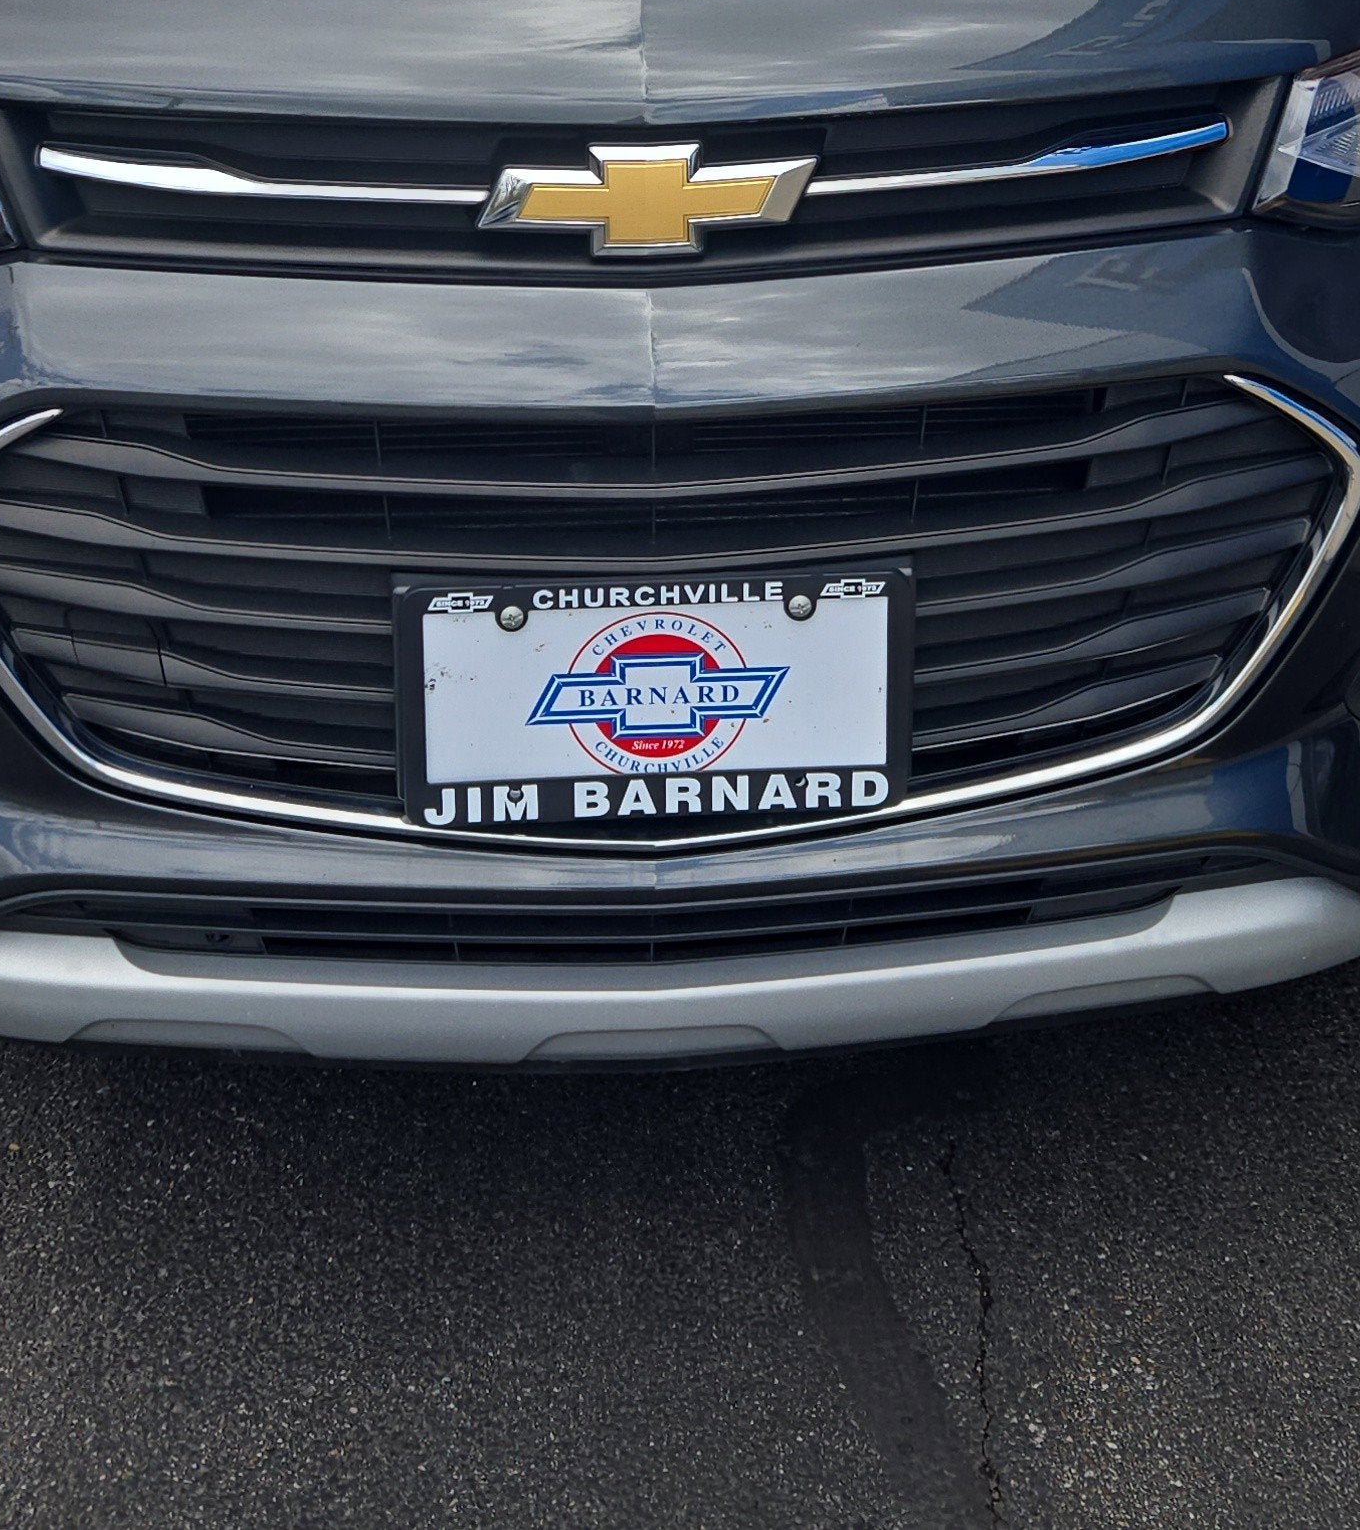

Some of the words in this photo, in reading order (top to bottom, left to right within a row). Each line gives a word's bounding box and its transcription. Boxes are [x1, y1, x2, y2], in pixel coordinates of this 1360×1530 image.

[532, 581, 784, 611] CHURCHVILLE
[592, 619, 727, 655] CHEVROLET
[578, 684, 740, 708] BARNARD
[594, 736, 725, 773] CHURCHVILLE
[631, 740, 660, 750] Since
[661, 739, 686, 750] 1972
[424, 785, 539, 826] JIM
[573, 771, 889, 818] BARNARD
